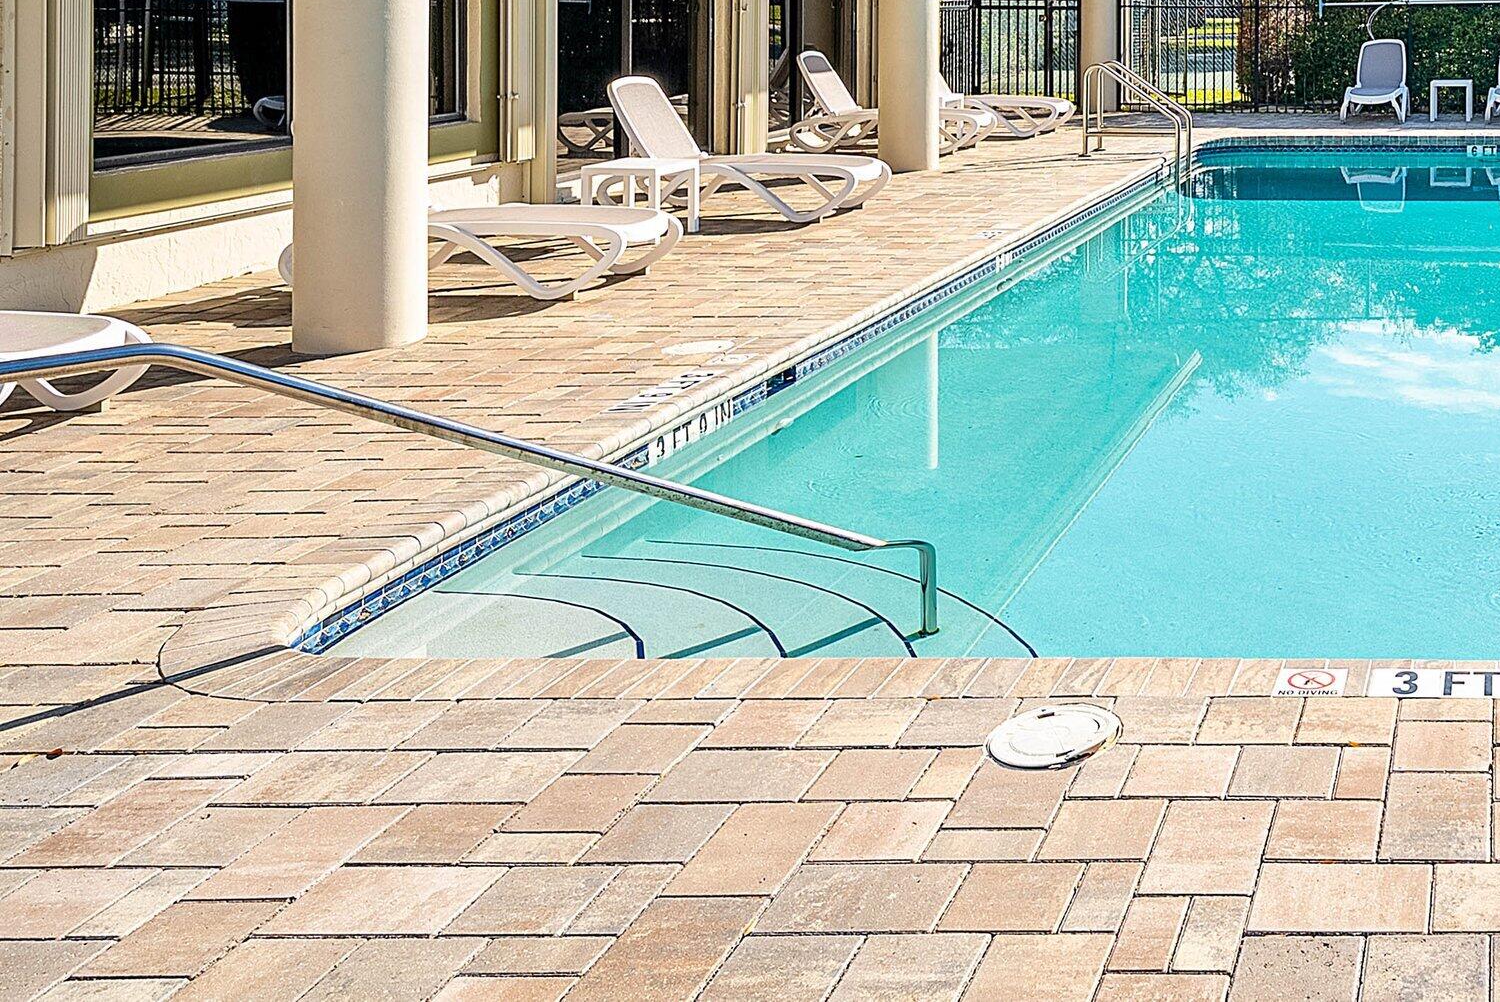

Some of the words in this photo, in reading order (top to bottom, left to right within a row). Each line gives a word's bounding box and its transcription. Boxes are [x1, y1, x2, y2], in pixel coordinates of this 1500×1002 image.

[656, 435, 665, 457] 3
[672, 419, 692, 449] FT
[714, 398, 731, 425] IN
[1391, 670, 1419, 696] 3
